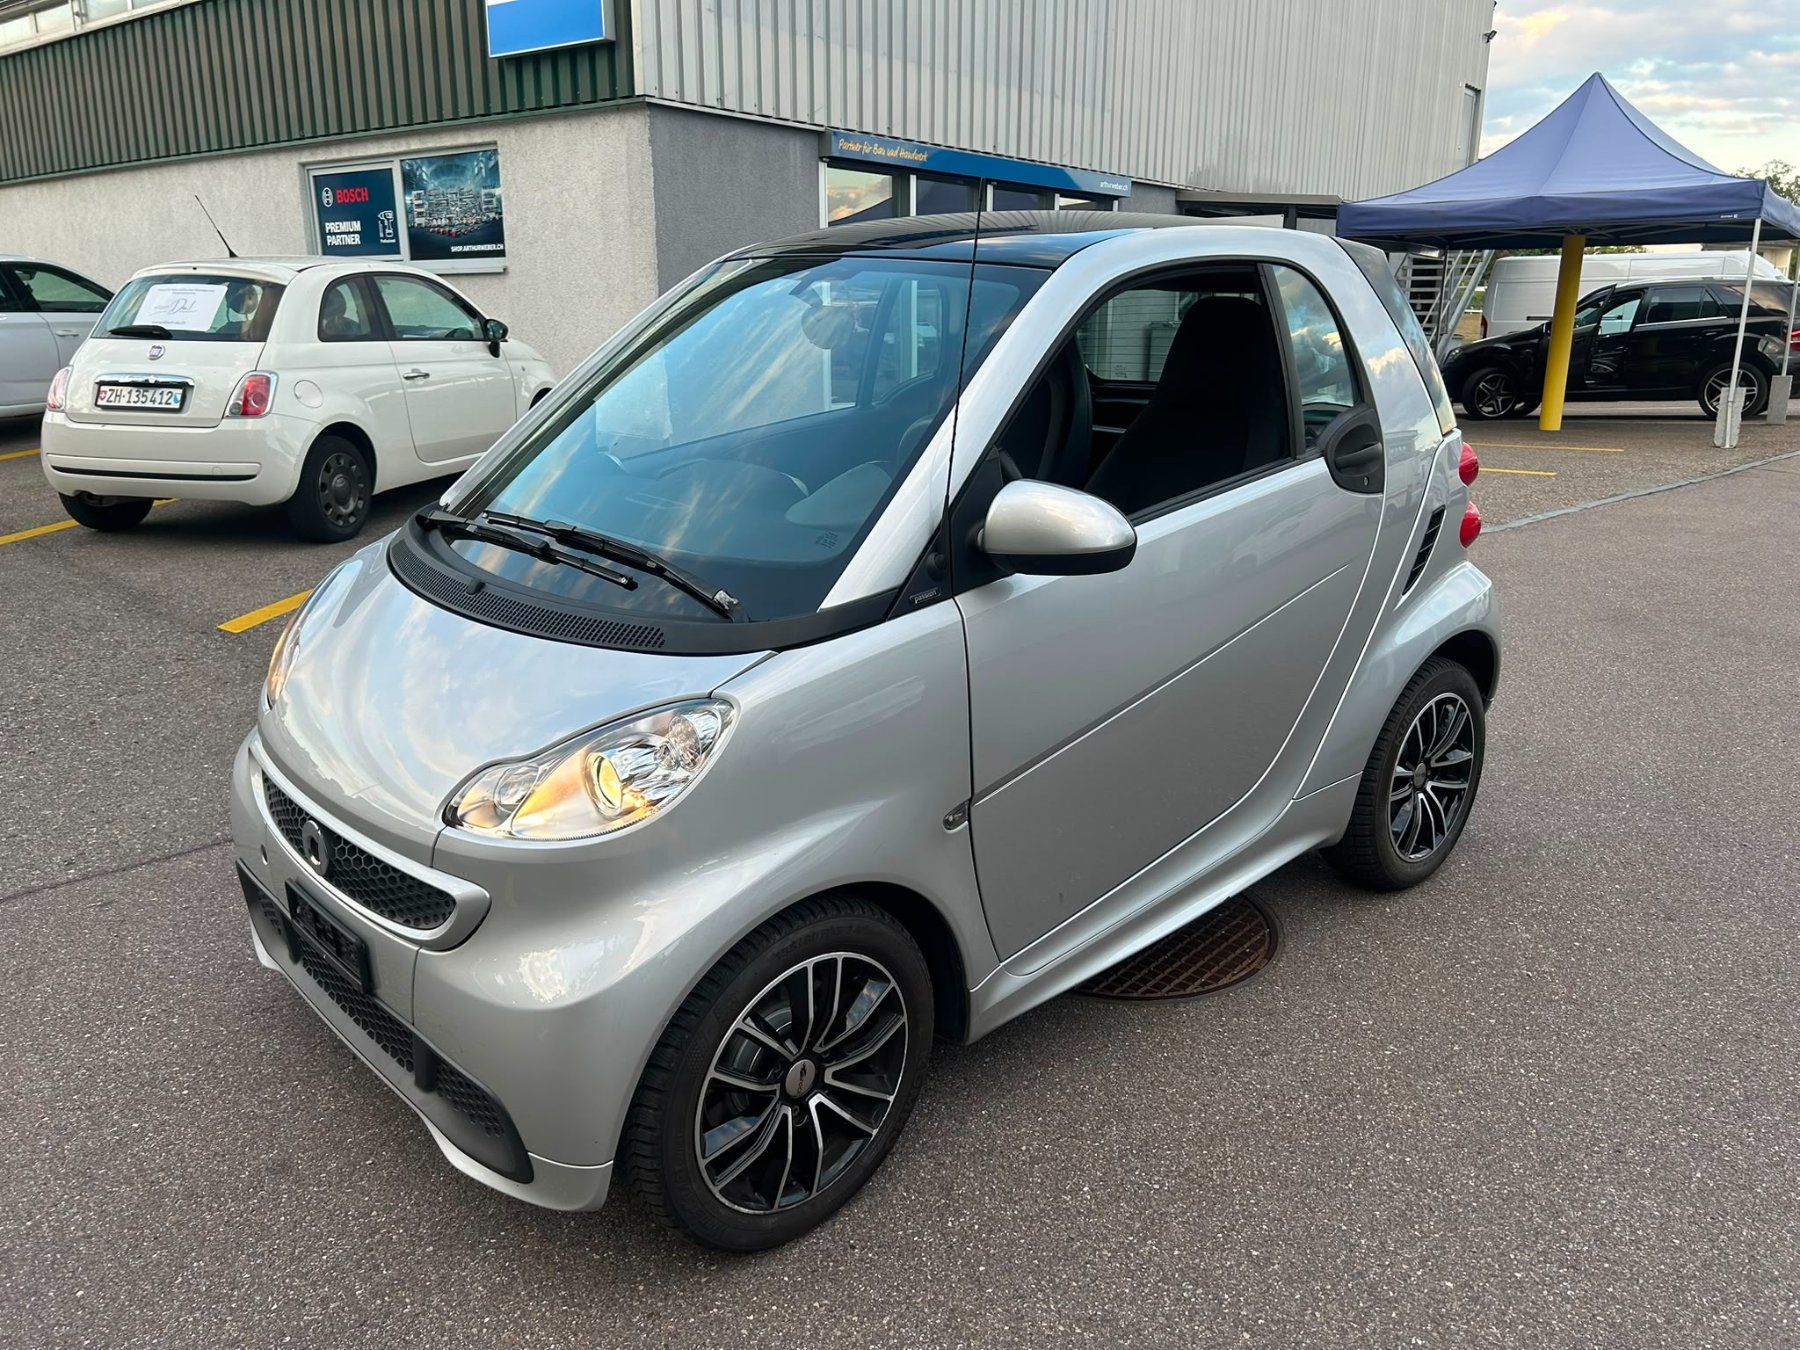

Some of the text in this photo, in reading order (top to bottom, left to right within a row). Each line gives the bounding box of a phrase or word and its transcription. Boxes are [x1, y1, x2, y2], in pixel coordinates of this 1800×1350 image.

[839, 138, 861, 151] Partner
[336, 187, 368, 203] BOSCH
[325, 220, 361, 233] PREMIUM
[326, 233, 361, 246] PARTNER
